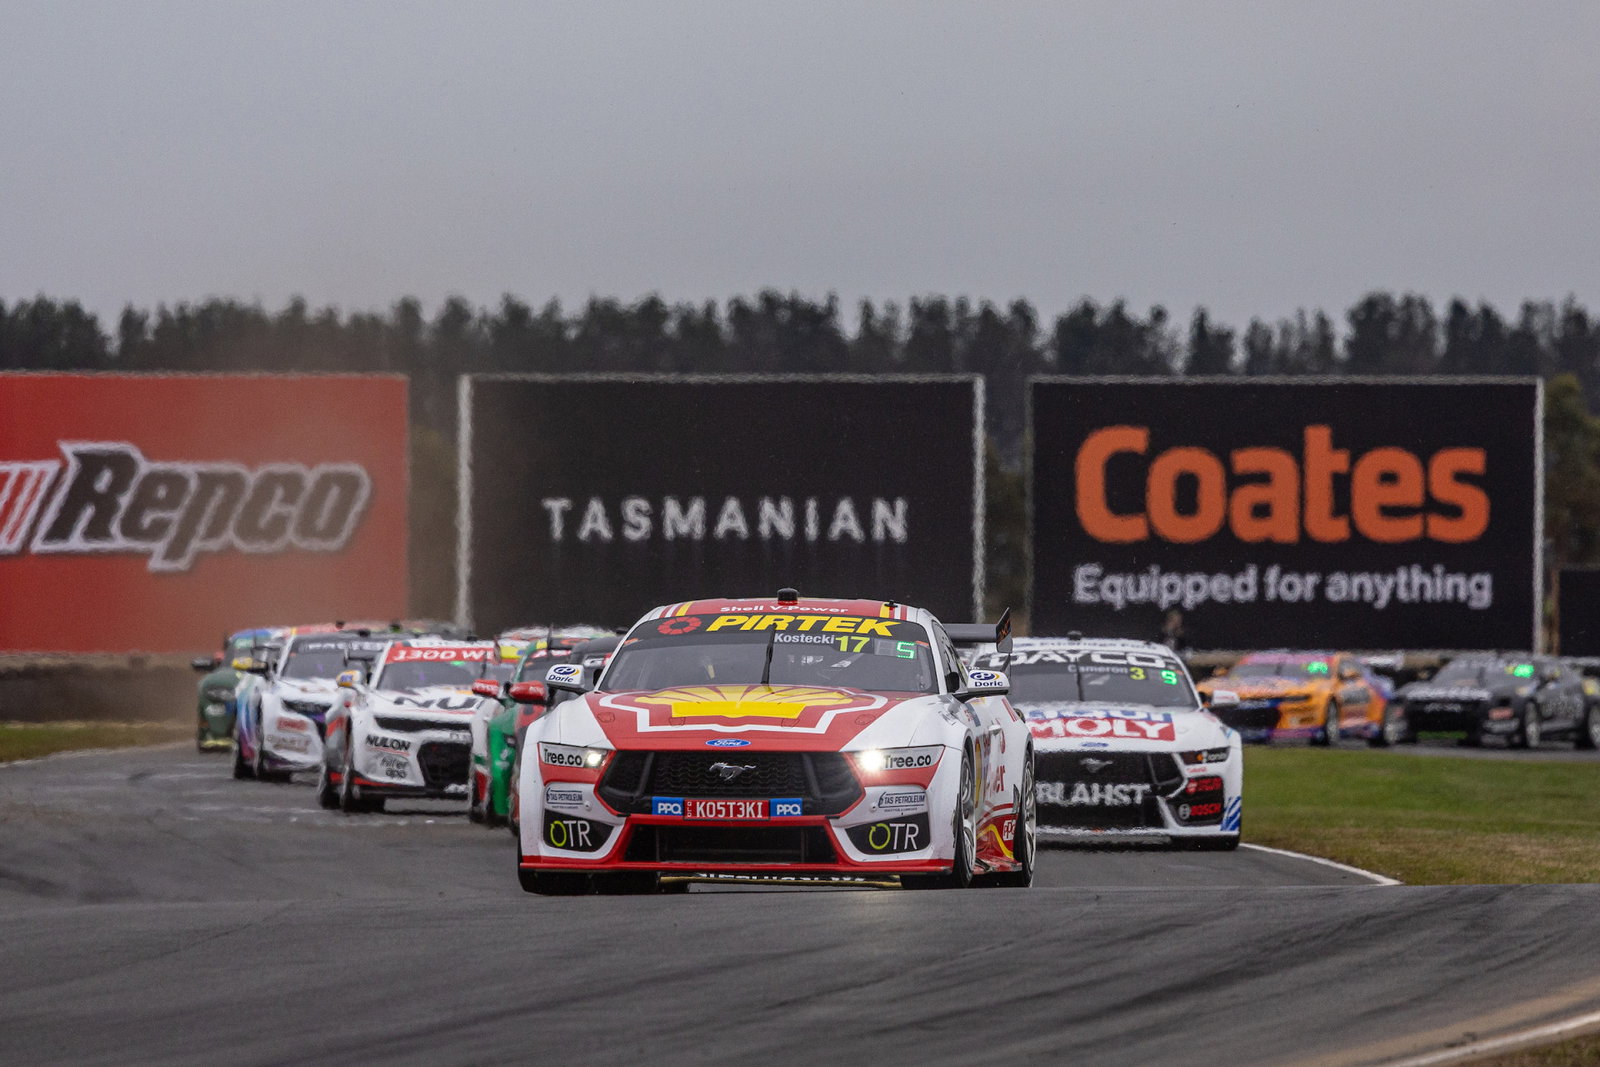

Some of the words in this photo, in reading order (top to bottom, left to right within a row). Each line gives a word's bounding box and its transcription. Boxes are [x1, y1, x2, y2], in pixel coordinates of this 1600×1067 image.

[1075, 424, 1491, 544] Coates
[31, 440, 372, 573] Repco
[541, 496, 908, 543] TASMANIAN
[1073, 562, 1258, 611] Equipped
[1264, 564, 1321, 602] for
[1325, 564, 1493, 610] anything
[706, 615, 901, 637] PIRTEK
[773, 632, 834, 645] Kostecki
[835, 636, 870, 653] 17
[1067, 664, 1128, 674] Cameron
[1129, 667, 1146, 680] 3
[548, 674, 574, 683] Doric
[1026, 718, 1170, 739] MOLY
[366, 734, 411, 750] NULON
[544, 749, 582, 766] Tree.co
[885, 754, 932, 768] Tree.co
[657, 803, 682, 815] PPQ
[776, 804, 801, 816] PPQ
[549, 820, 592, 847] OTR
[868, 823, 919, 850] OTR
